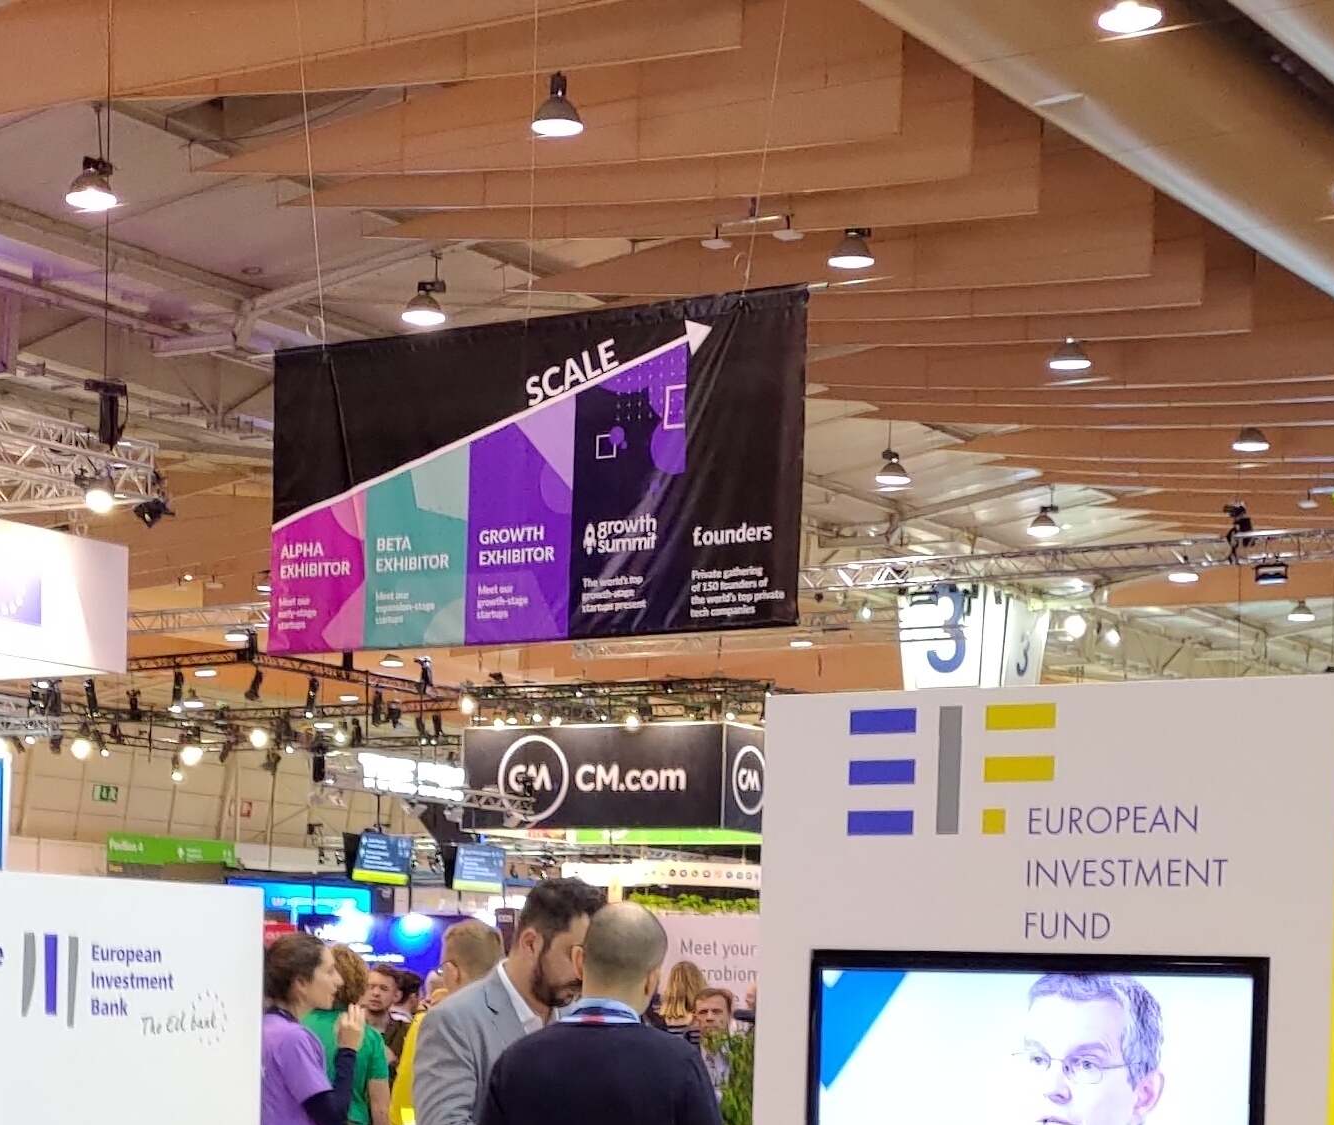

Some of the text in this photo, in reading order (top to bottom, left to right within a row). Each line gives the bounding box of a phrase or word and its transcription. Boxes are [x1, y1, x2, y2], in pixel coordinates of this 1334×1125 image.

[524, 338, 619, 407] SCALE
[479, 525, 545, 545] GROWTH
[597, 513, 658, 540] growth
[280, 541, 324, 560] ALPHA
[376, 535, 411, 552] BETA
[597, 533, 657, 554] summit
[376, 554, 449, 573] EXHIBITOR
[478, 546, 555, 566] EXHIBITOR
[280, 560, 351, 579] EXHIBITOR
[477, 583, 514, 596] Meet our
[582, 577, 598, 588] The
[690, 582, 702, 592] of
[758, 577, 769, 588] of
[375, 591, 394, 601] Meet
[576, 763, 687, 793] CM.com
[738, 768, 760, 792] CM
[1028, 805, 1199, 835] EUROPEAN
[1026, 859, 1228, 887] INVESTMENT
[1024, 912, 1110, 940] FUND
[91, 944, 162, 967] European
[680, 938, 757, 959] Meet your
[91, 970, 174, 990] Investment
[91, 996, 128, 1016] Bank
[141, 1016, 162, 1036] The
